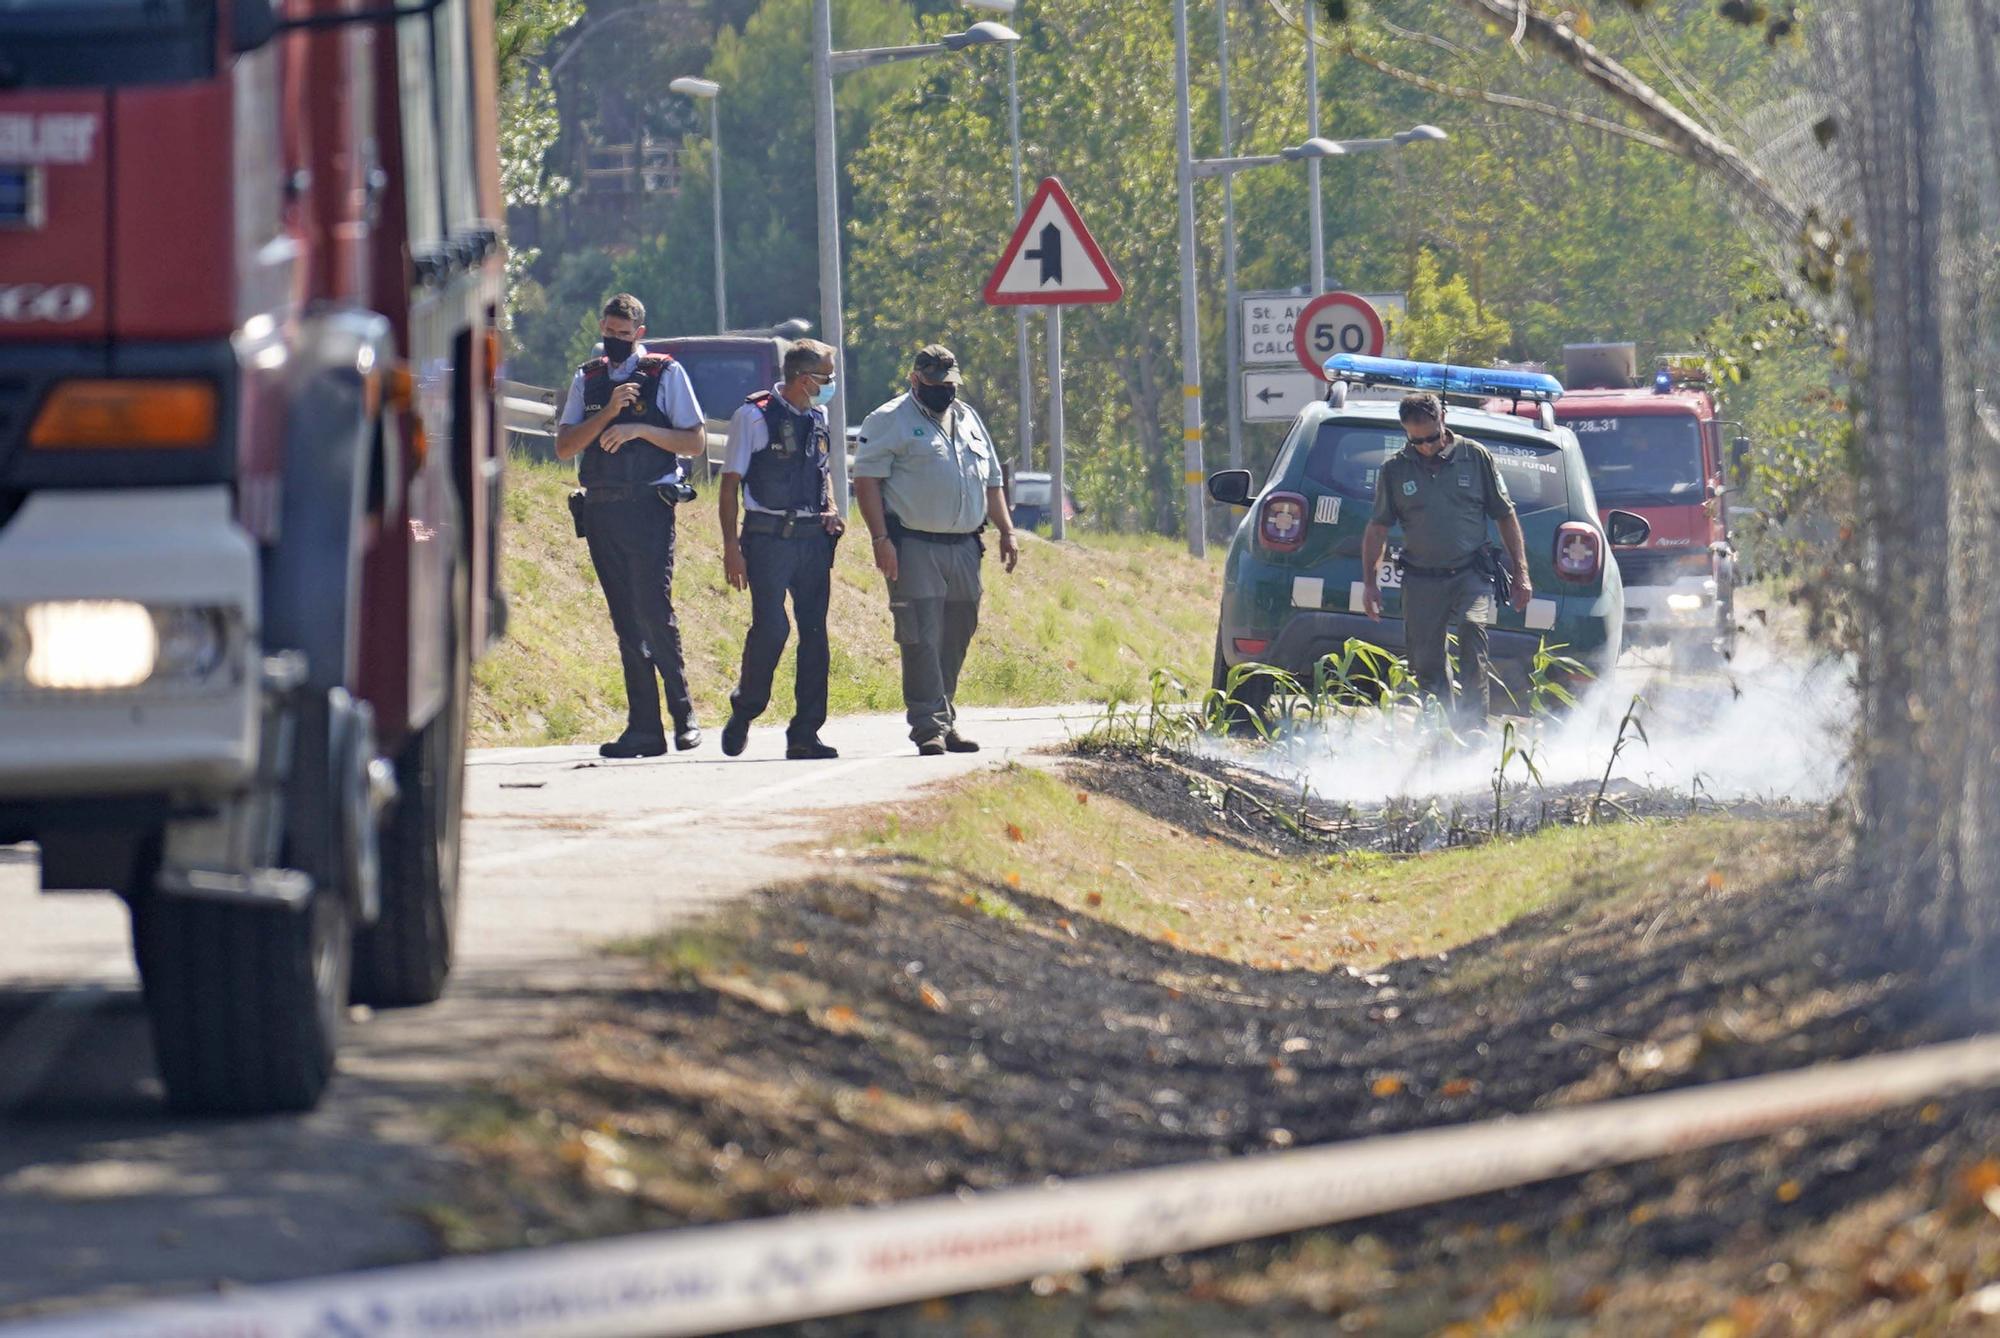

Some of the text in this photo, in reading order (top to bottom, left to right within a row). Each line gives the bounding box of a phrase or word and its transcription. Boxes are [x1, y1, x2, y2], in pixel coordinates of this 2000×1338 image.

[1252, 323, 1270, 334] DE
[1314, 323, 1364, 353] 50
[1522, 460, 1557, 474] rurals
